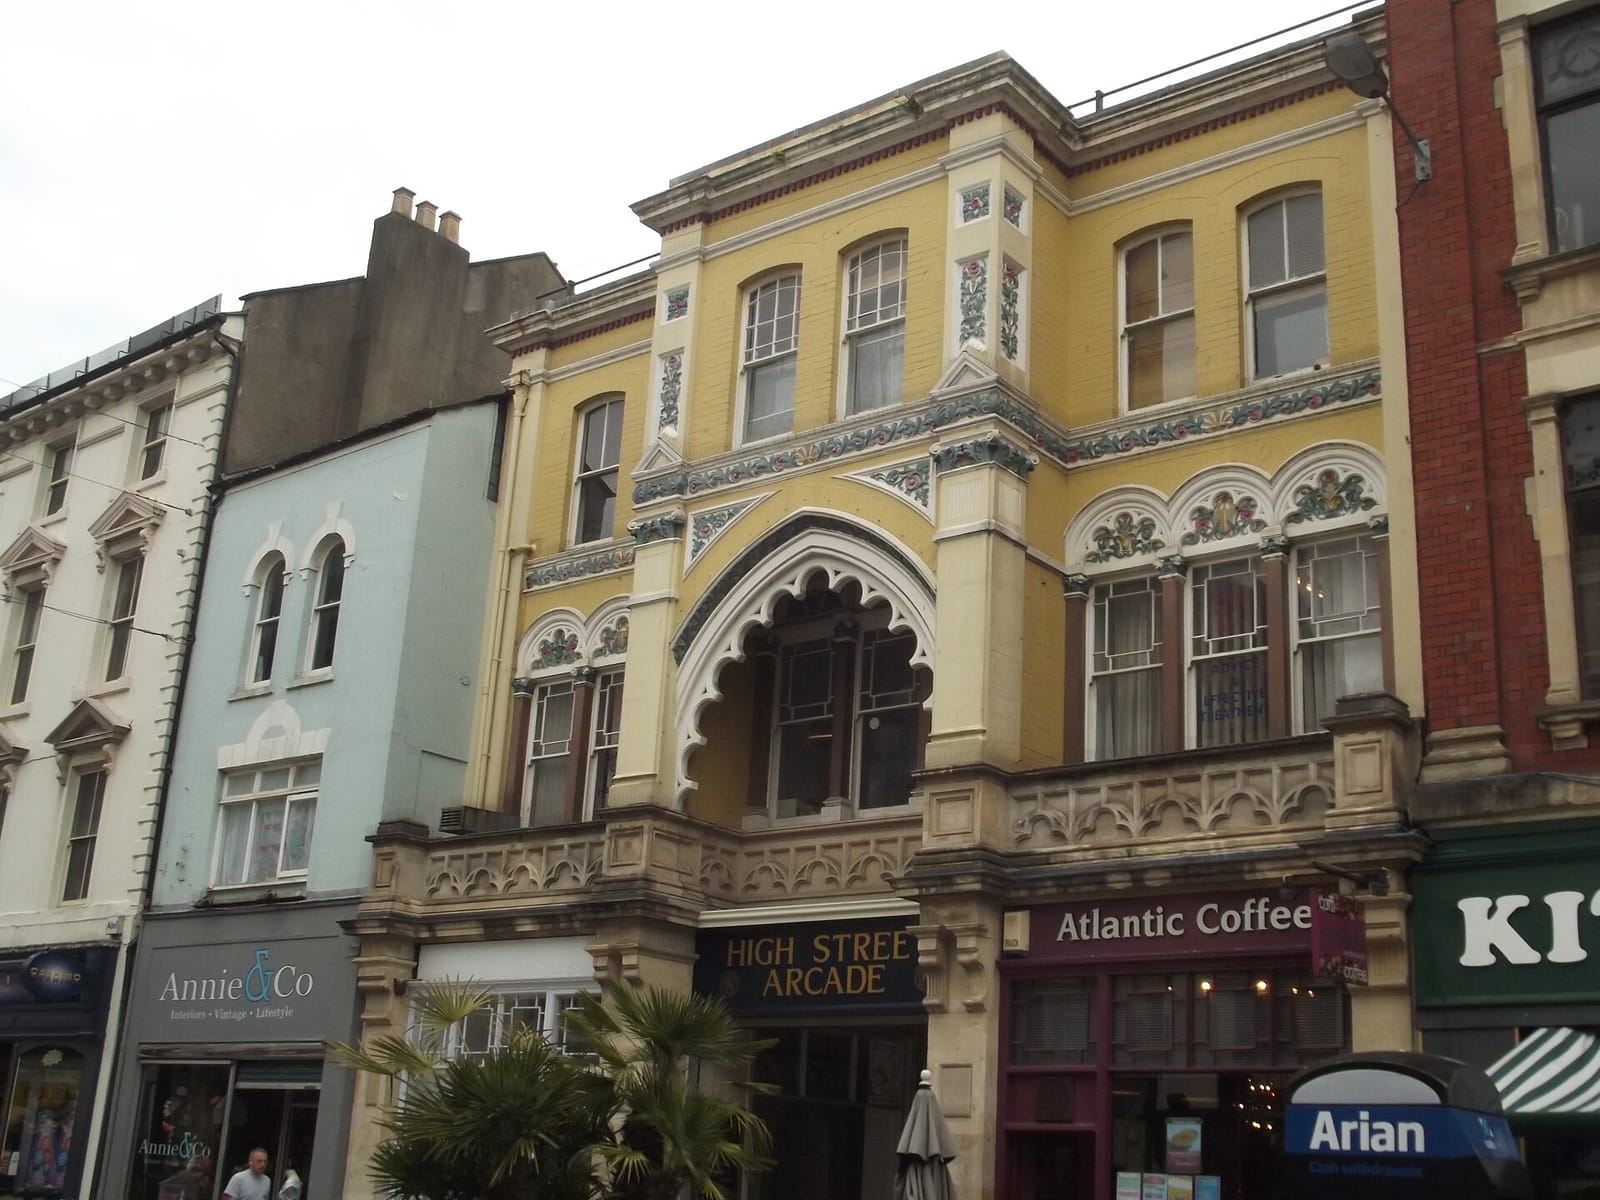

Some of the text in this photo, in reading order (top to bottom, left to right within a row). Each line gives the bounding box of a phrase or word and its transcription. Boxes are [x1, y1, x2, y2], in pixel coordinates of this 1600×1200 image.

[1212, 659, 1260, 673] ADVICE
[1056, 897, 1313, 942] Atlantic Coffee
[1457, 889, 1600, 967] KI
[726, 930, 912, 967] HIGH STREE
[762, 964, 887, 997] ARCADE
[170, 1006, 294, 1022] Interiors Vintage Lifestyle
[1309, 1110, 1425, 1153] Arian
